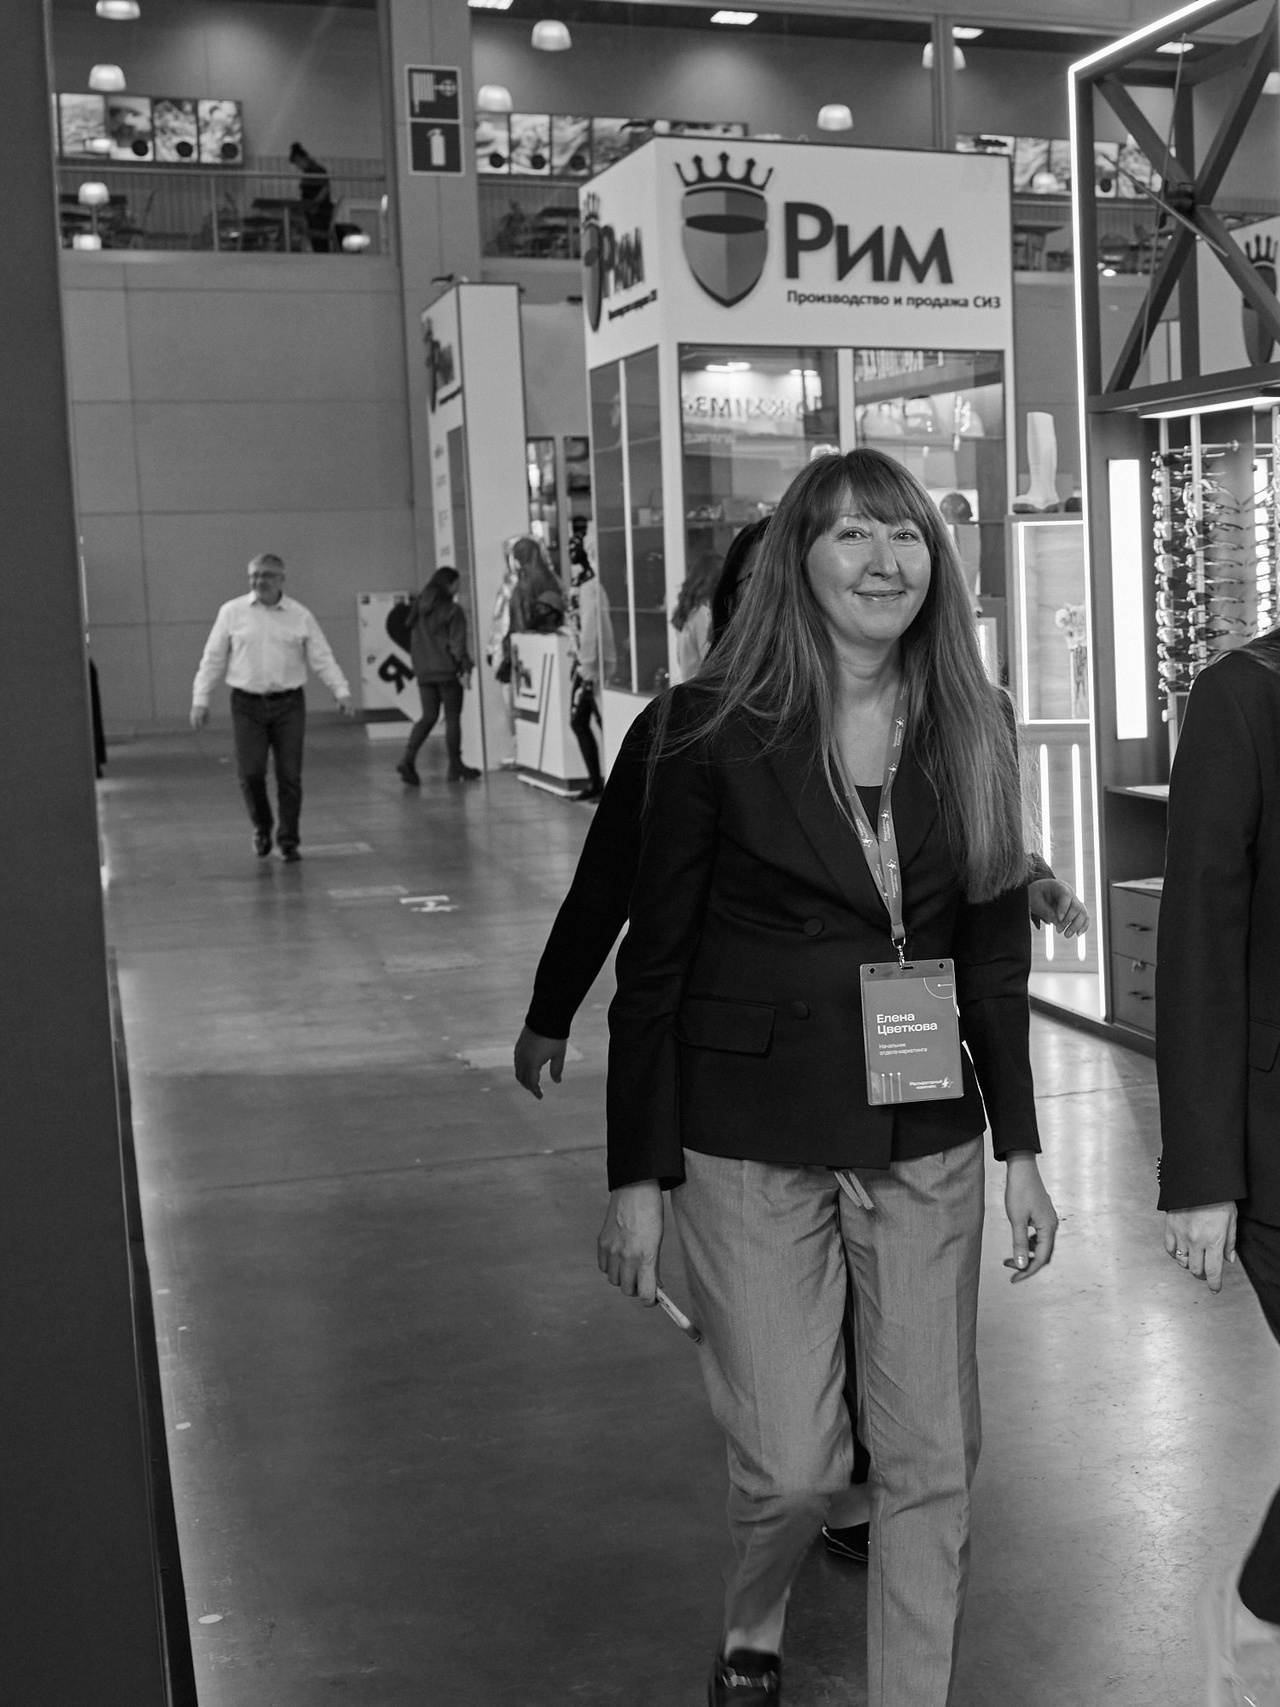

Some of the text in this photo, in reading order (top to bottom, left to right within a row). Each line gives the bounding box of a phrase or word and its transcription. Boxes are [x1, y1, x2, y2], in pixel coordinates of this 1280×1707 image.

[787, 290, 1000, 308] Производство и продажа СИЗ
[876, 1013, 915, 1023] Елена
[877, 1022, 938, 1035] Цветкова
